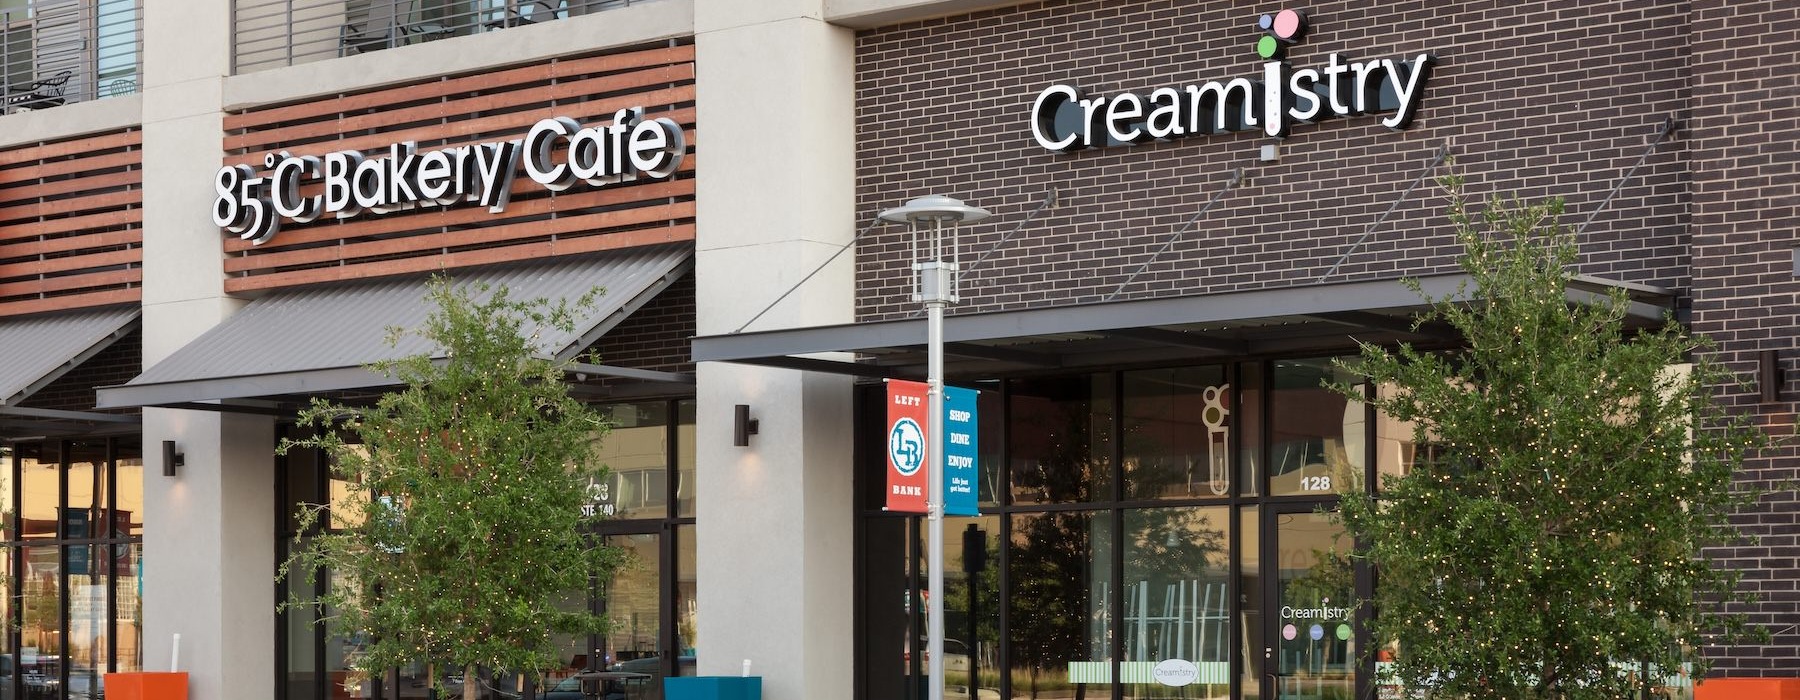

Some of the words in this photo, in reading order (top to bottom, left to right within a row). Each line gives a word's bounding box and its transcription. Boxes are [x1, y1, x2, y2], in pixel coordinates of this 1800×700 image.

[1030, 9, 1427, 152] Creamistry
[325, 141, 508, 213] Bakery
[522, 107, 668, 186] Cafe
[894, 394, 920, 406] LEFT
[949, 410, 970, 422] SHOP
[950, 433, 969, 445] DINE
[948, 455, 973, 469] ENJOY
[1301, 476, 1331, 491] 128
[893, 485, 921, 496] BANK
[599, 504, 614, 516] 140
[1281, 597, 1349, 622] Creamistry
[1155, 665, 1196, 678] Creamistry
